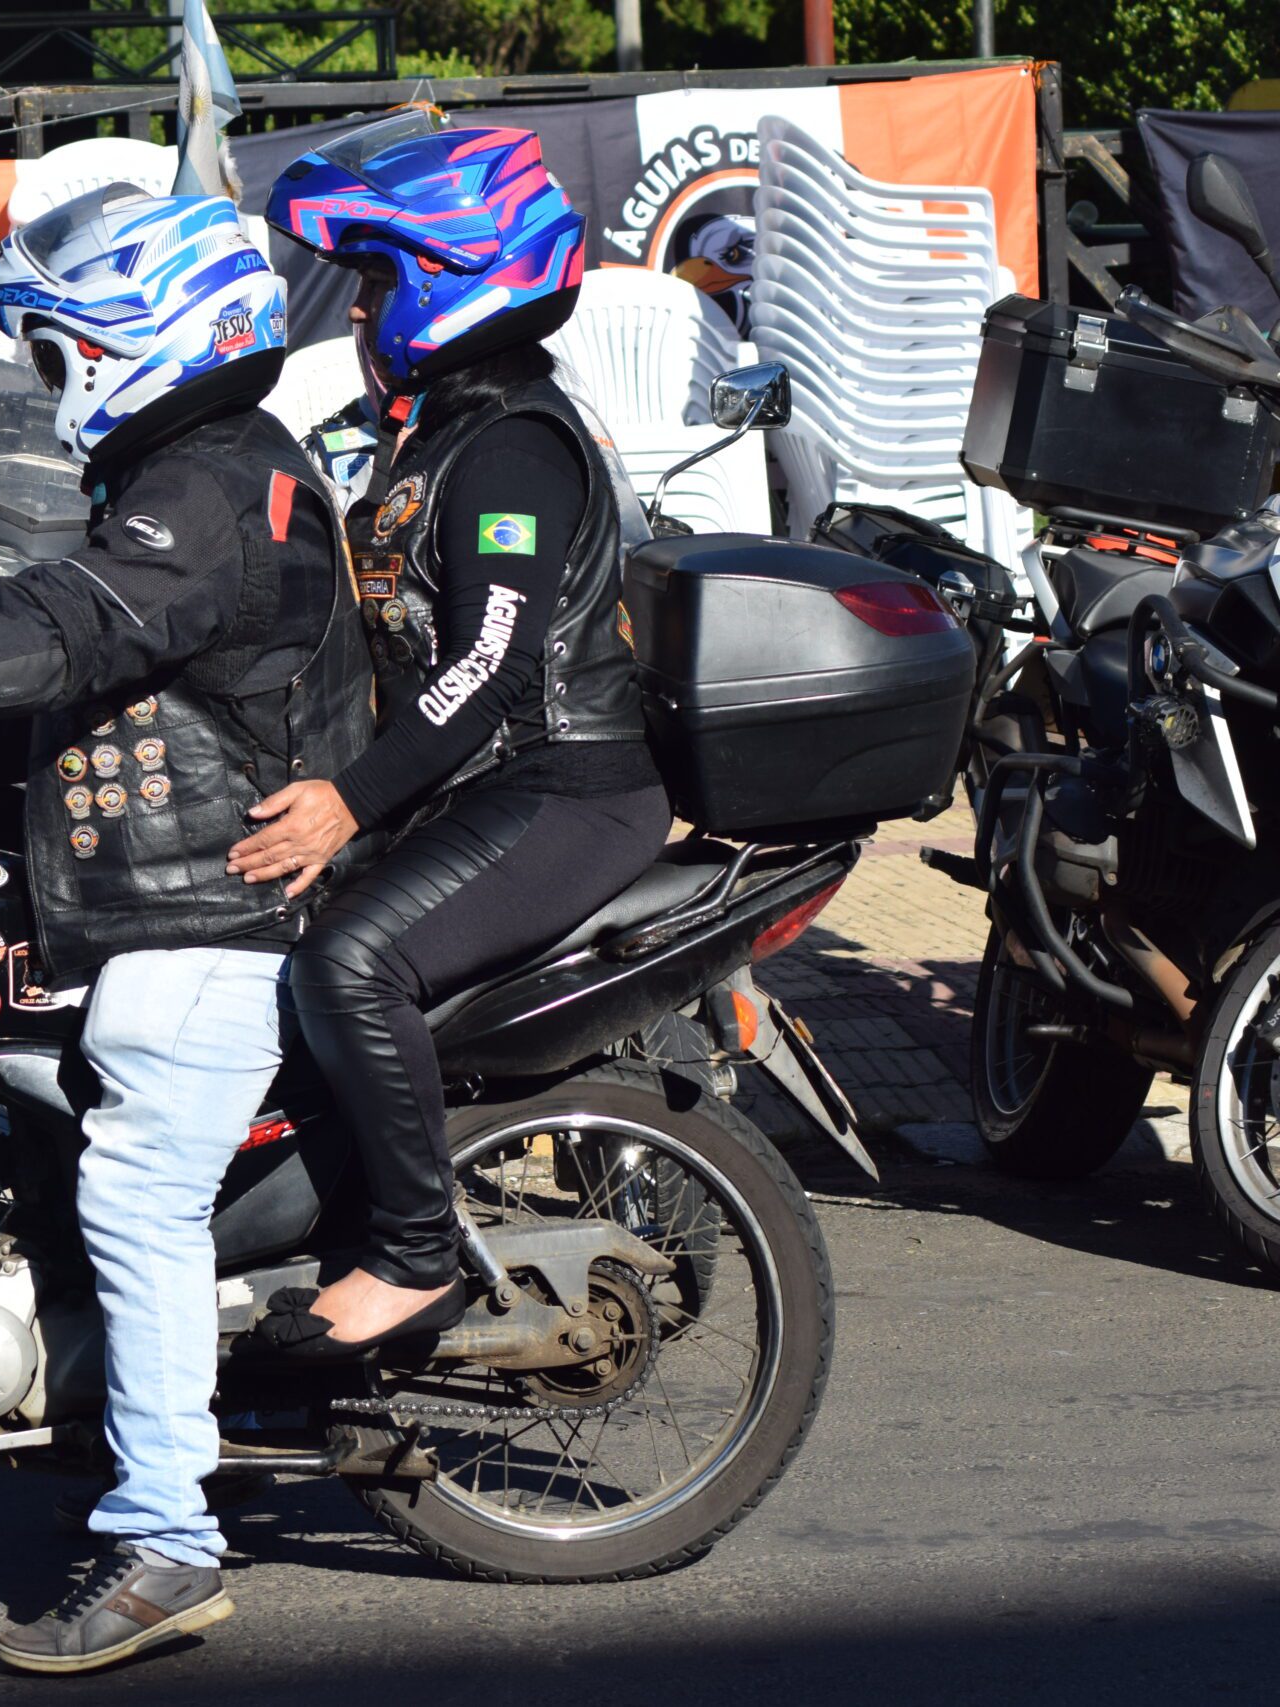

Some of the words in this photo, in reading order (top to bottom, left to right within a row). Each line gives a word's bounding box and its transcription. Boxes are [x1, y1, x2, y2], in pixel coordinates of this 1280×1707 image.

[321, 198, 371, 217] EVO
[603, 131, 721, 258] ÁGUIAS
[729, 138, 761, 163] DE
[234, 253, 267, 274] ATTA
[3, 287, 39, 307] EVO
[212, 311, 253, 344] JESUS
[272, 320, 283, 330] DOT
[474, 584, 527, 660] ÁGUIAS
[418, 658, 489, 726] CRISTO
